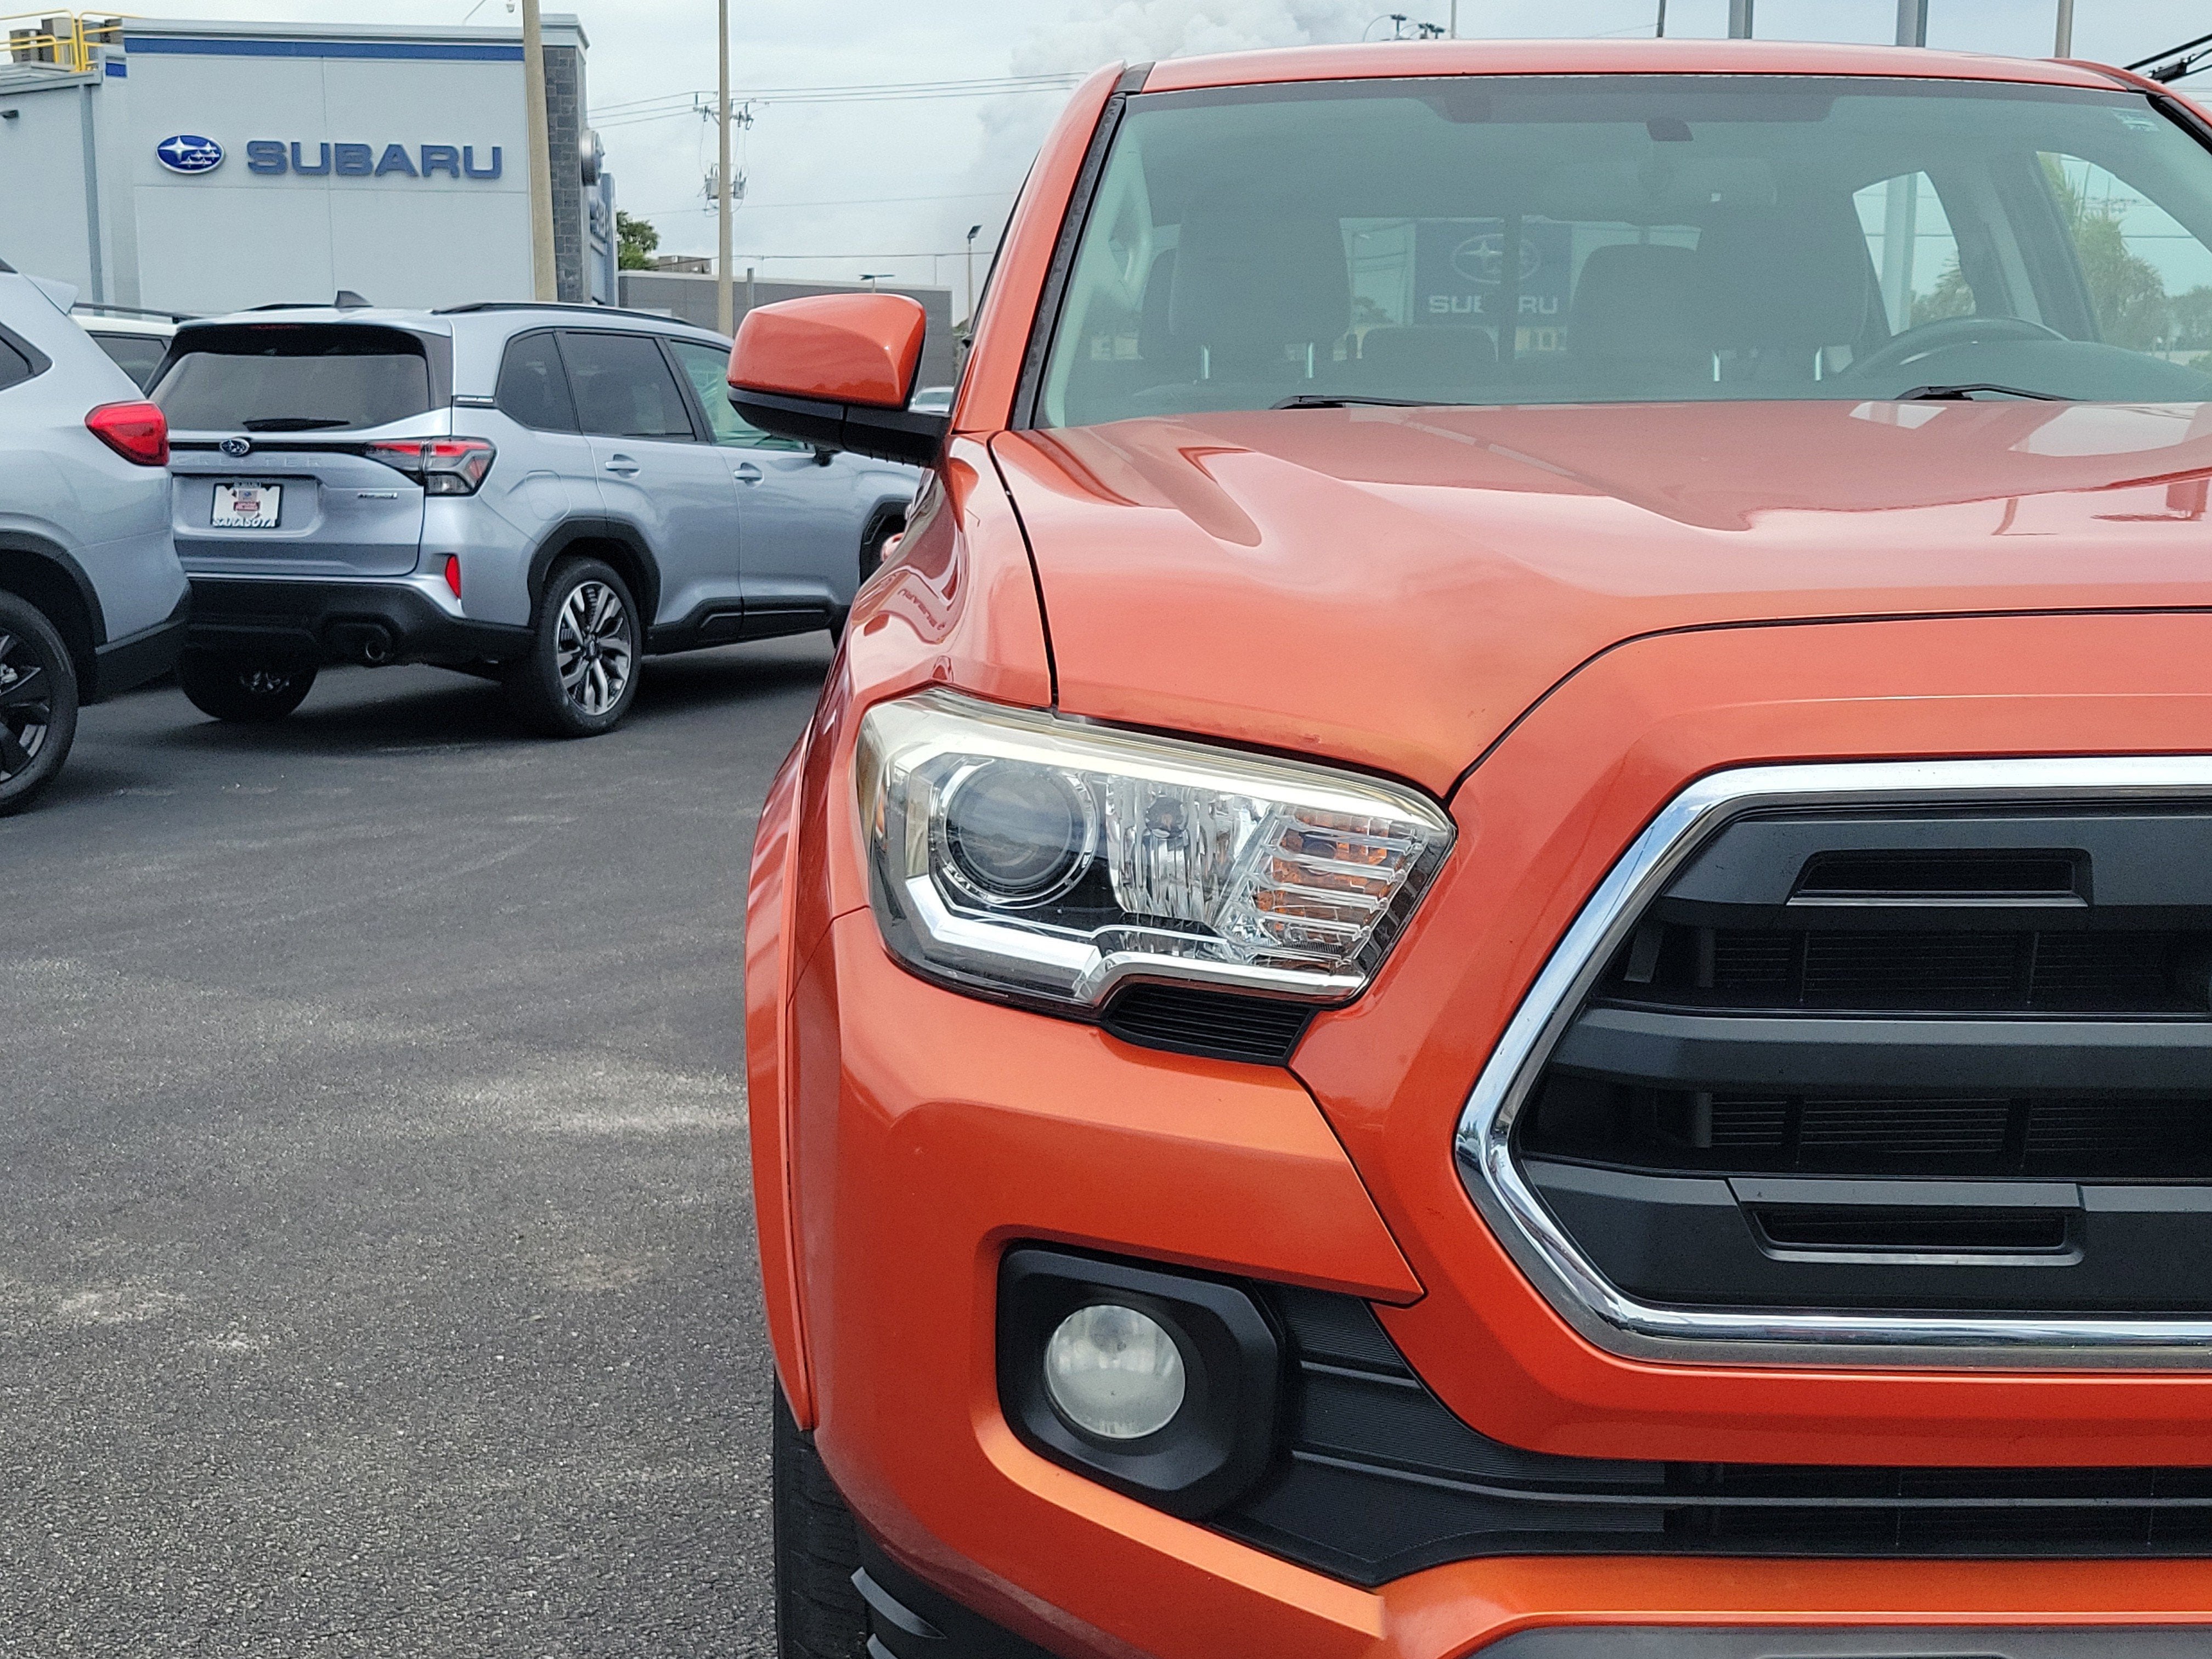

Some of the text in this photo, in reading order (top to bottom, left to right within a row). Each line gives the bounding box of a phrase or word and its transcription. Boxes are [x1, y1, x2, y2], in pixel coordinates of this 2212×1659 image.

[247, 140, 503, 179] SUBARU
[1429, 295, 1558, 314] SURU
[212, 518, 276, 527] SARASOTA
